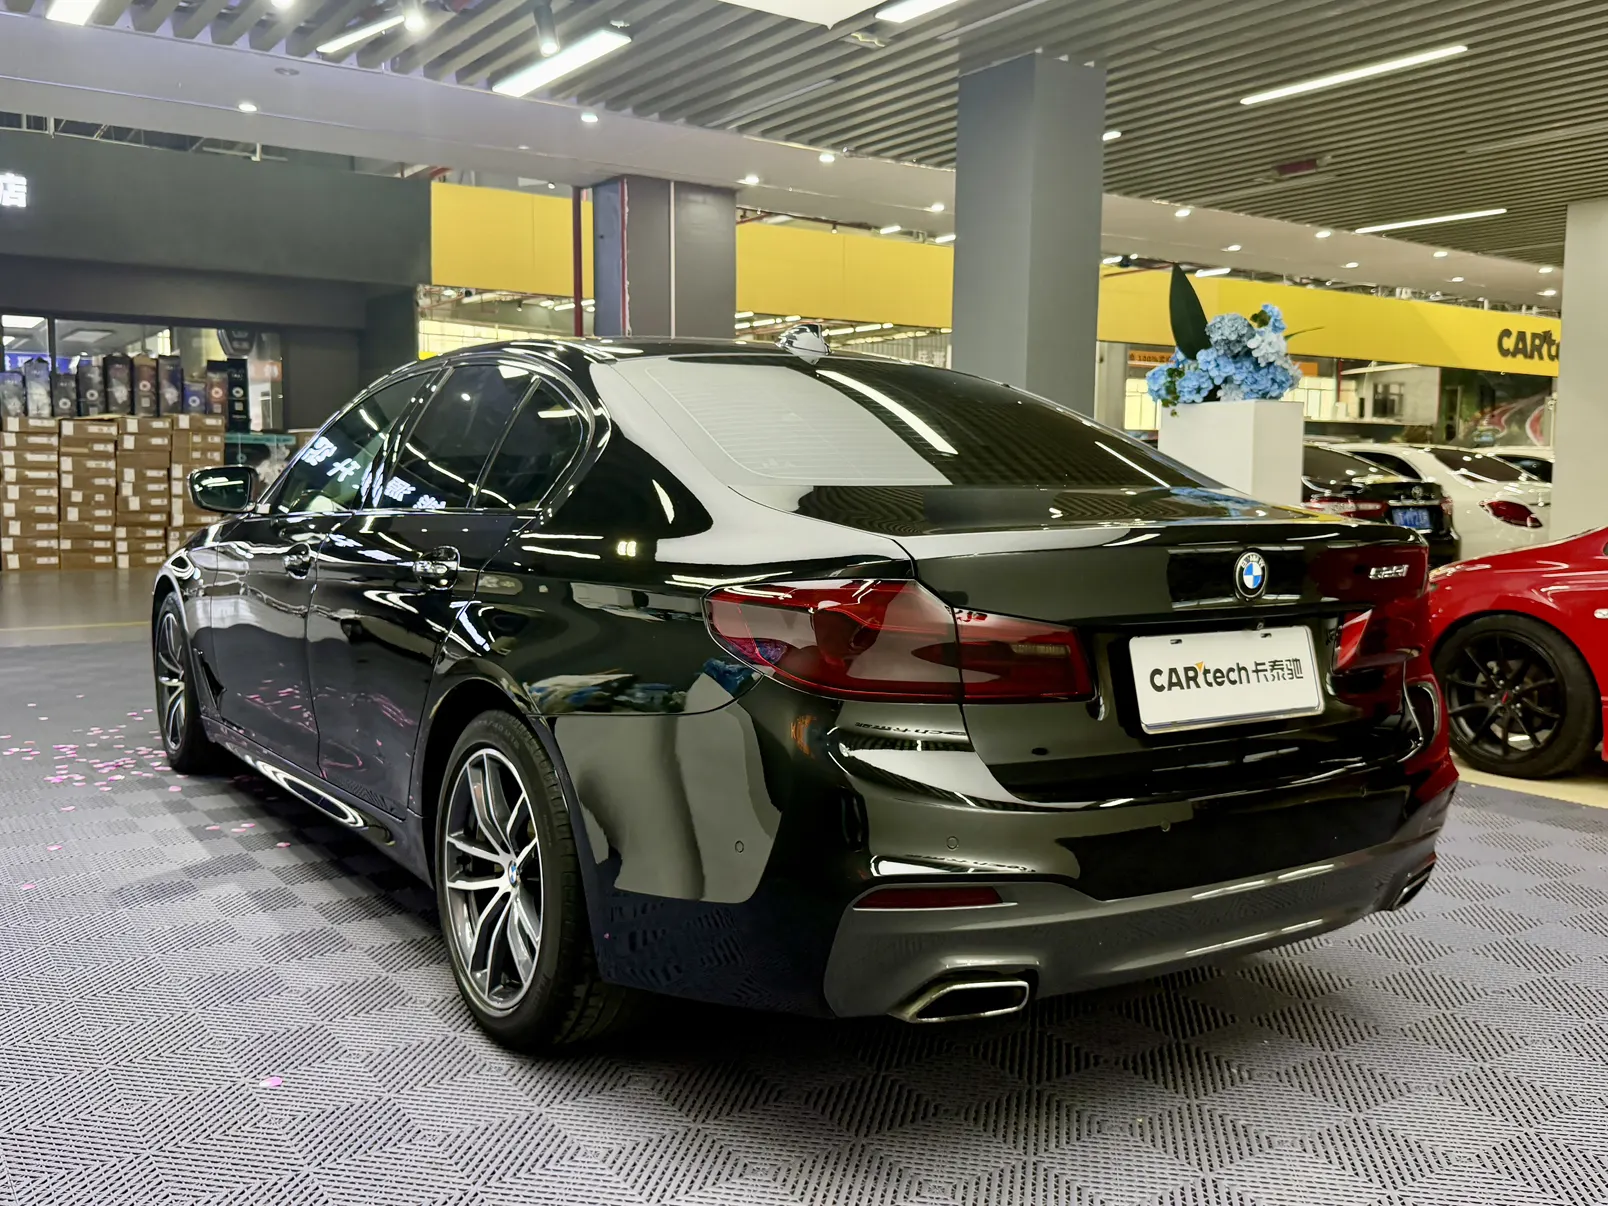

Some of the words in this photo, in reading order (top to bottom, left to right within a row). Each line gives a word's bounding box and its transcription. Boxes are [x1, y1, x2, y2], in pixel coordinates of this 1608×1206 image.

[0, 172, 27, 207] 店
[1497, 328, 1560, 362] CARt
[1239, 554, 1266, 569] BMW
